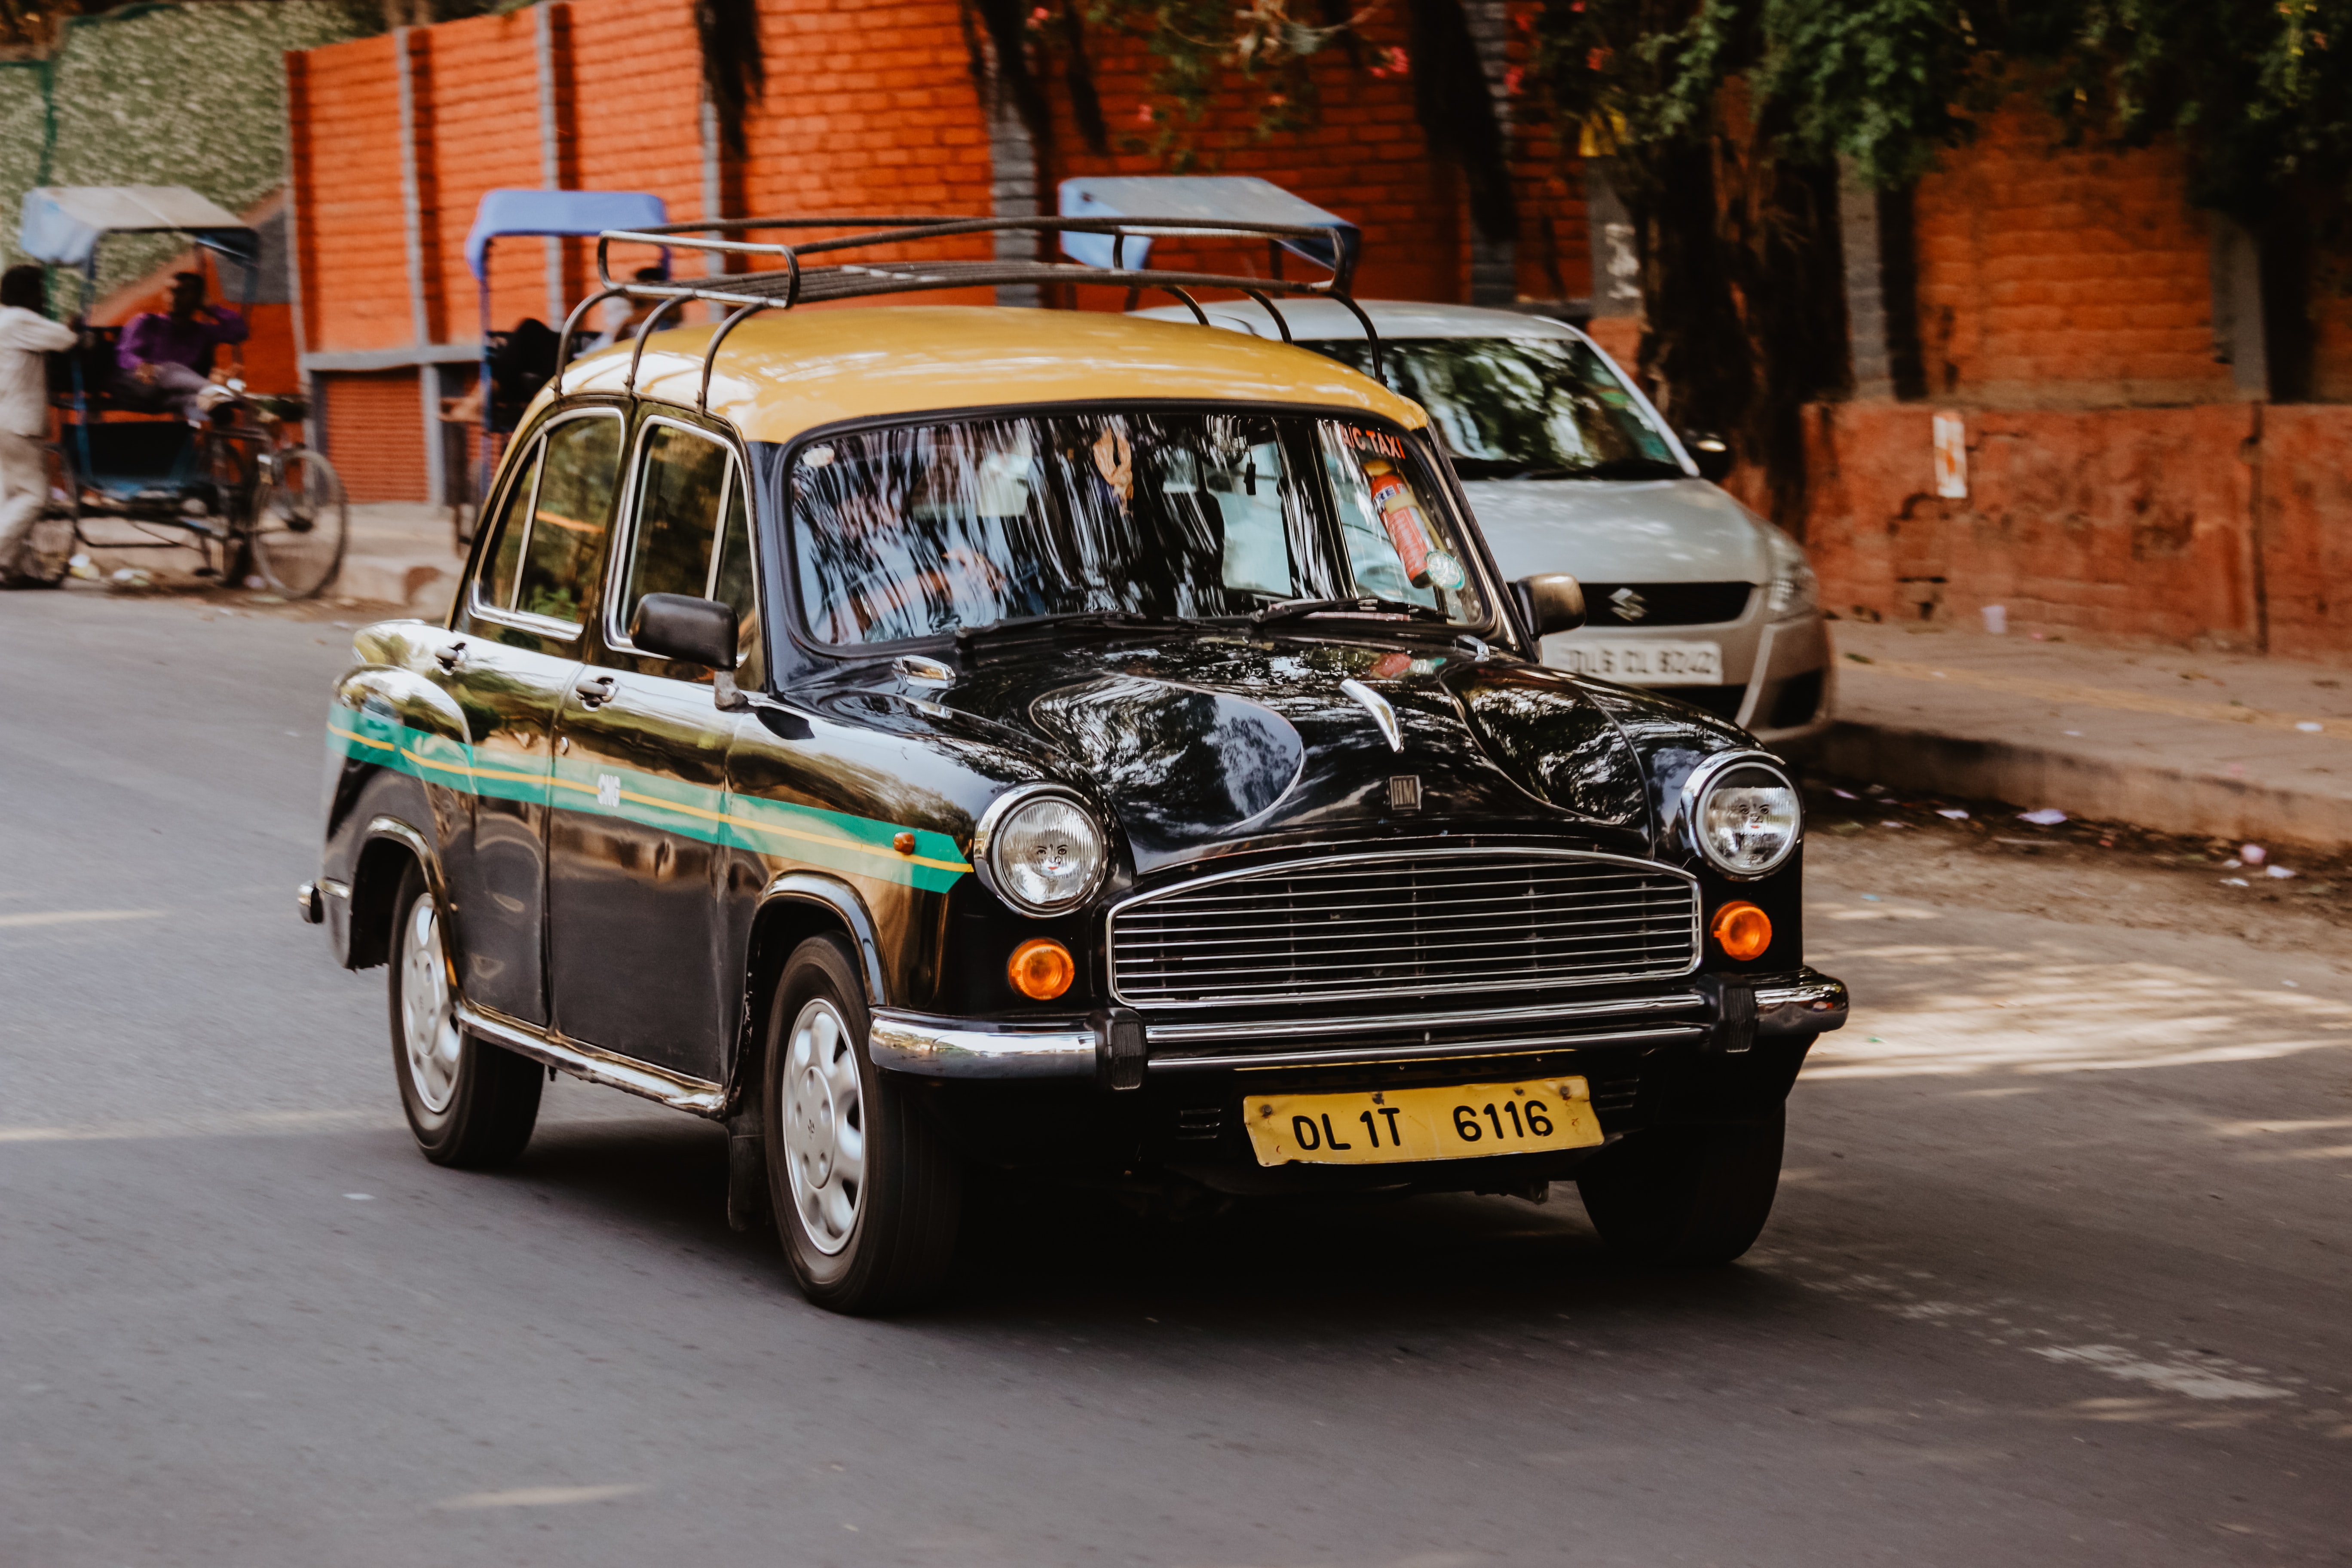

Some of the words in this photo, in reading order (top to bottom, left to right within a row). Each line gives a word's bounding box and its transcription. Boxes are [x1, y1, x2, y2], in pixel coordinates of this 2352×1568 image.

[1339, 424, 1366, 451] A/C
[1366, 430, 1406, 460] TAXI
[1393, 779, 1416, 805] HM
[1292, 1112, 1352, 1151] DL
[1360, 1107, 1401, 1148] 1T
[1453, 1099, 1554, 1142] 6116
